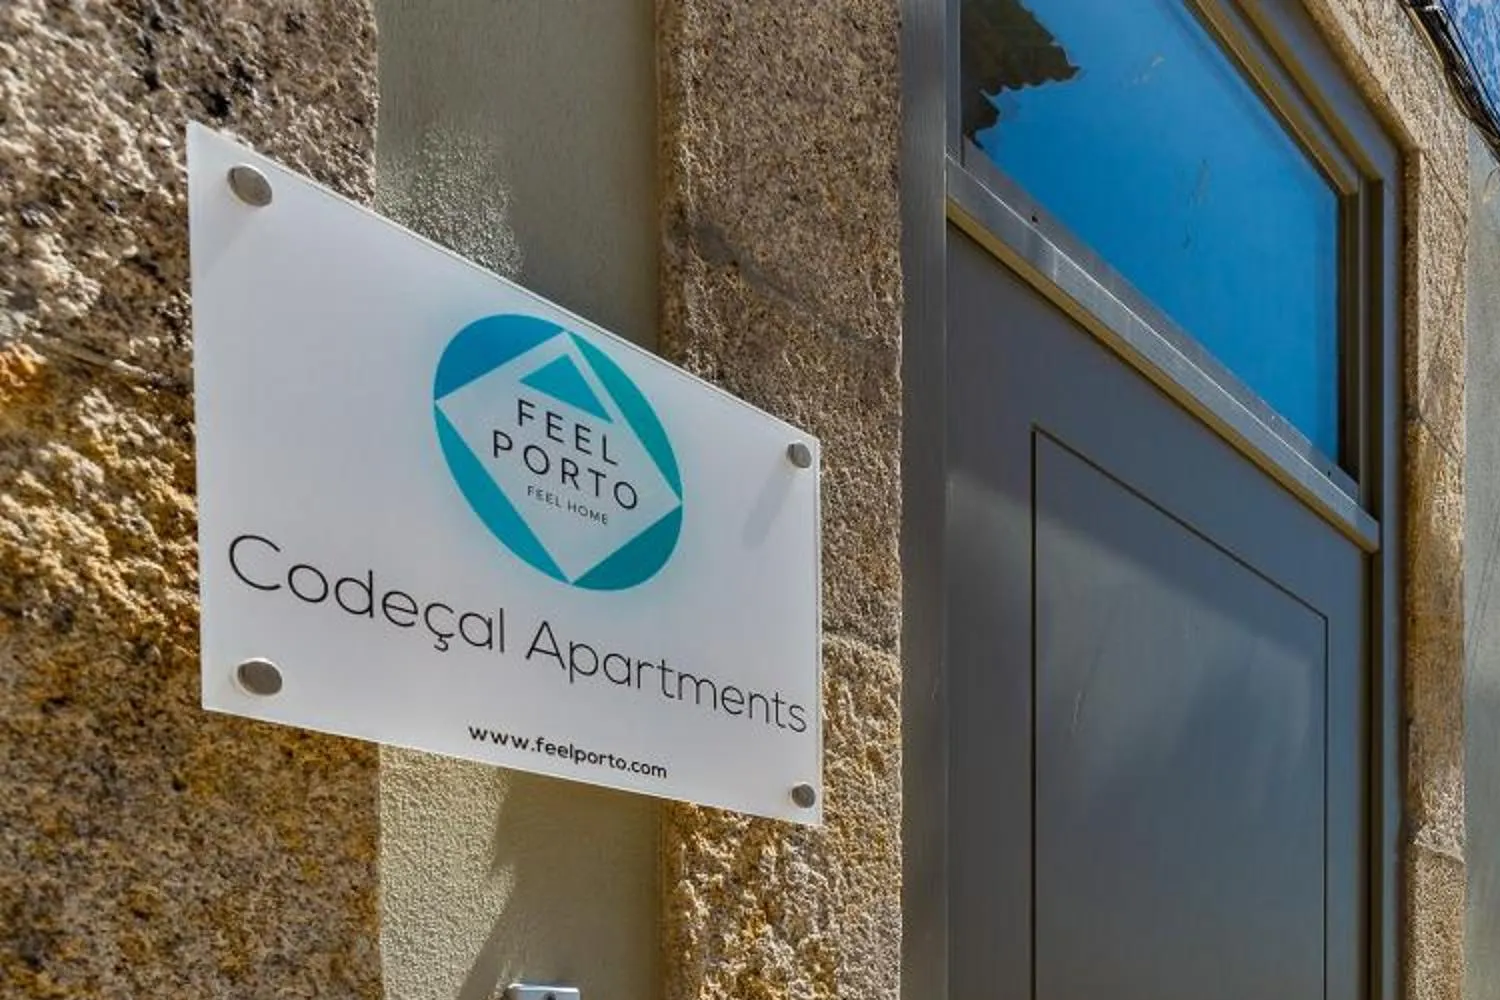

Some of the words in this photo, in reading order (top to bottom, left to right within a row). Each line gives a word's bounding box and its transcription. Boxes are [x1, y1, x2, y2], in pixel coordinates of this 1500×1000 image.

[517, 398, 618, 466] FEEL
[493, 429, 638, 510] PORTO
[527, 485, 562, 508] FEEL
[567, 501, 609, 525] HOME
[228, 534, 505, 653] Codeçal
[525, 620, 808, 733] Apartments
[468, 726, 668, 779] www.feelporto.com
